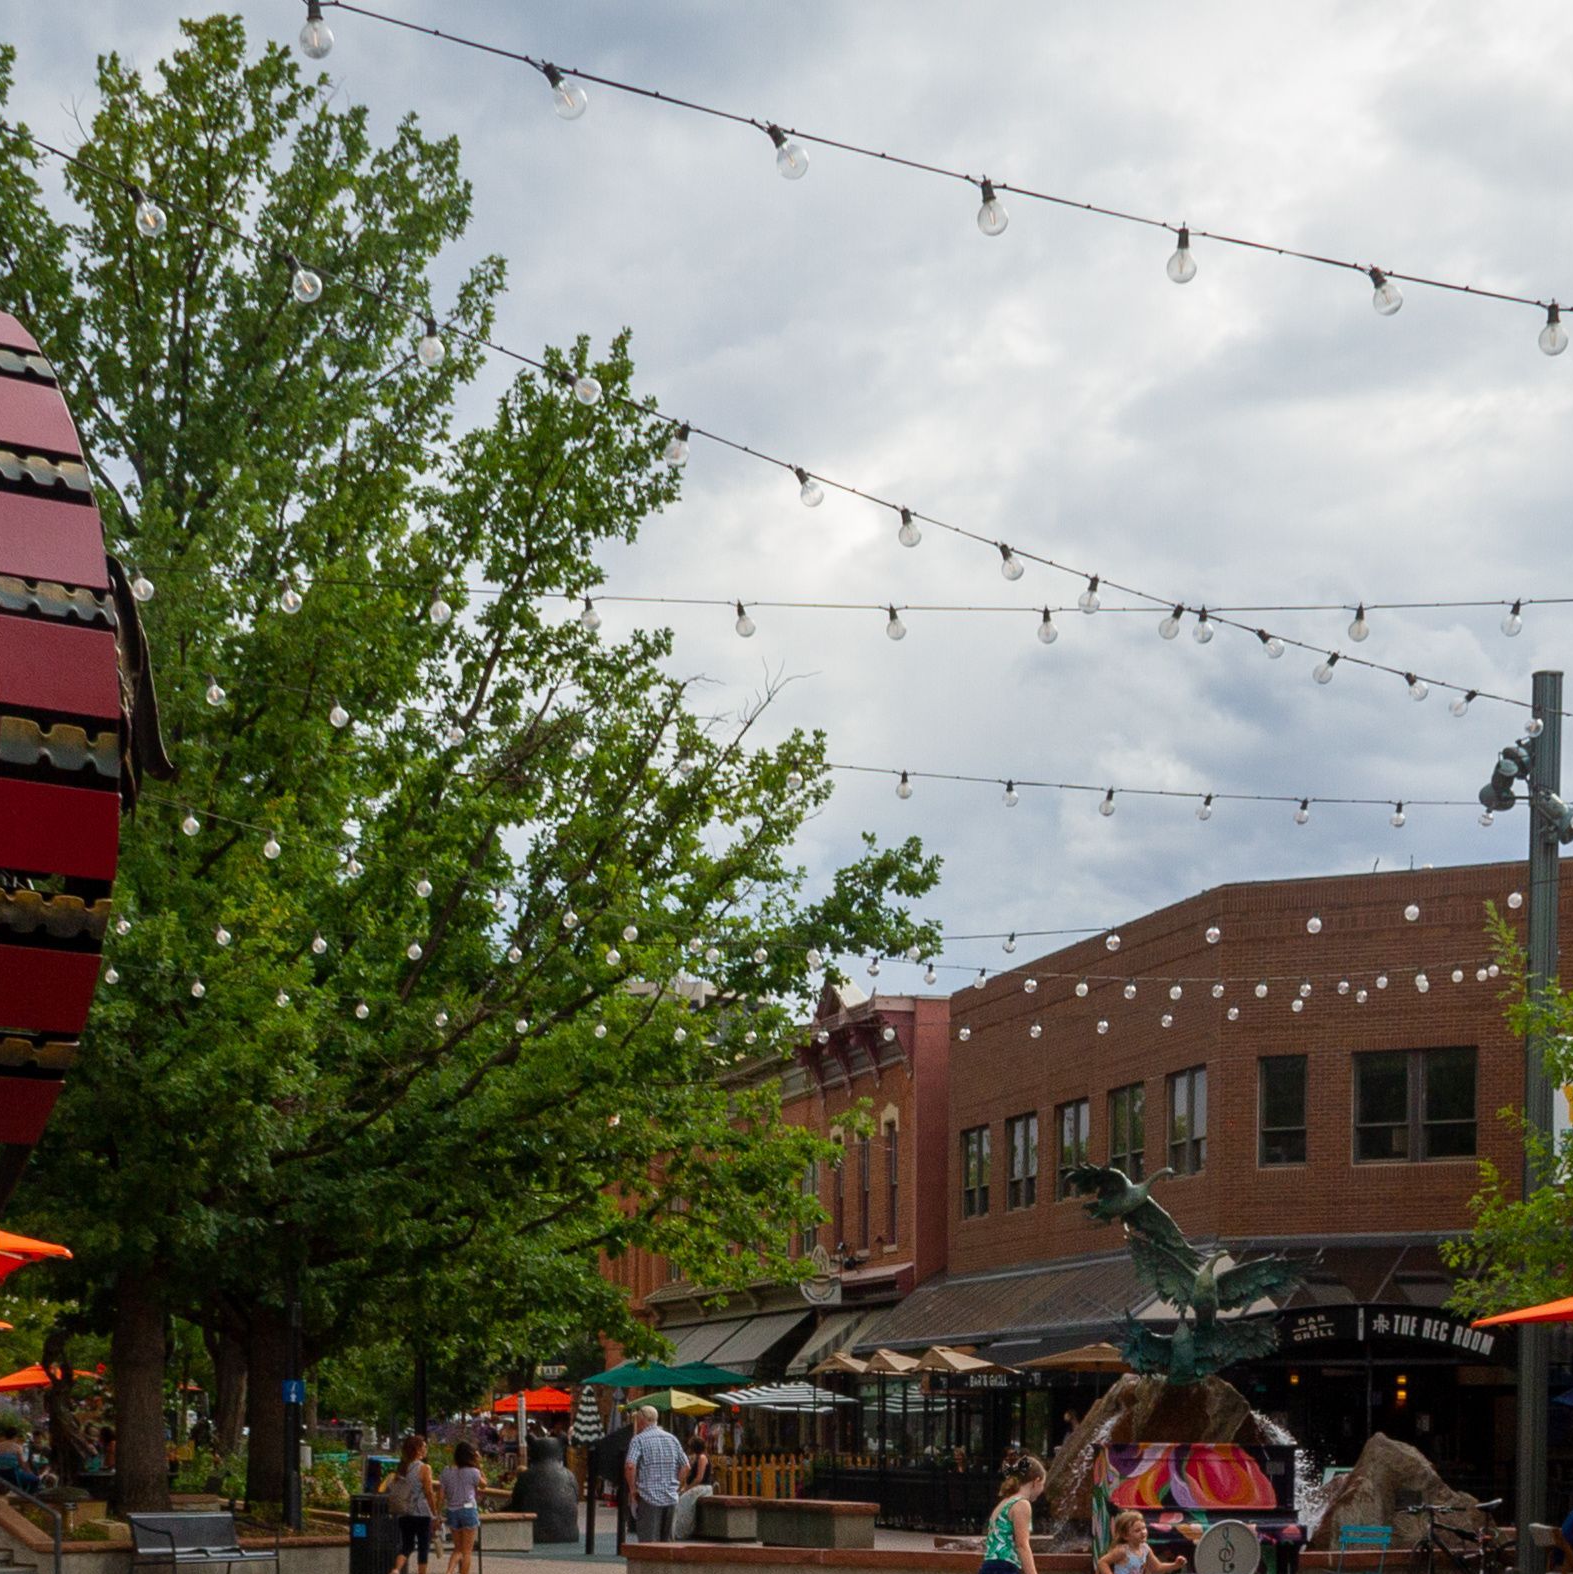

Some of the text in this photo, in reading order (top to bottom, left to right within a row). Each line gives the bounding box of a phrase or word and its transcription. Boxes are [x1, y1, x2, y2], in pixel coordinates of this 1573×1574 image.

[1298, 1314, 1326, 1326] BAR
[1293, 1328, 1335, 1341] GRILL
[1393, 1313, 1495, 1356] THE REC ROOM
